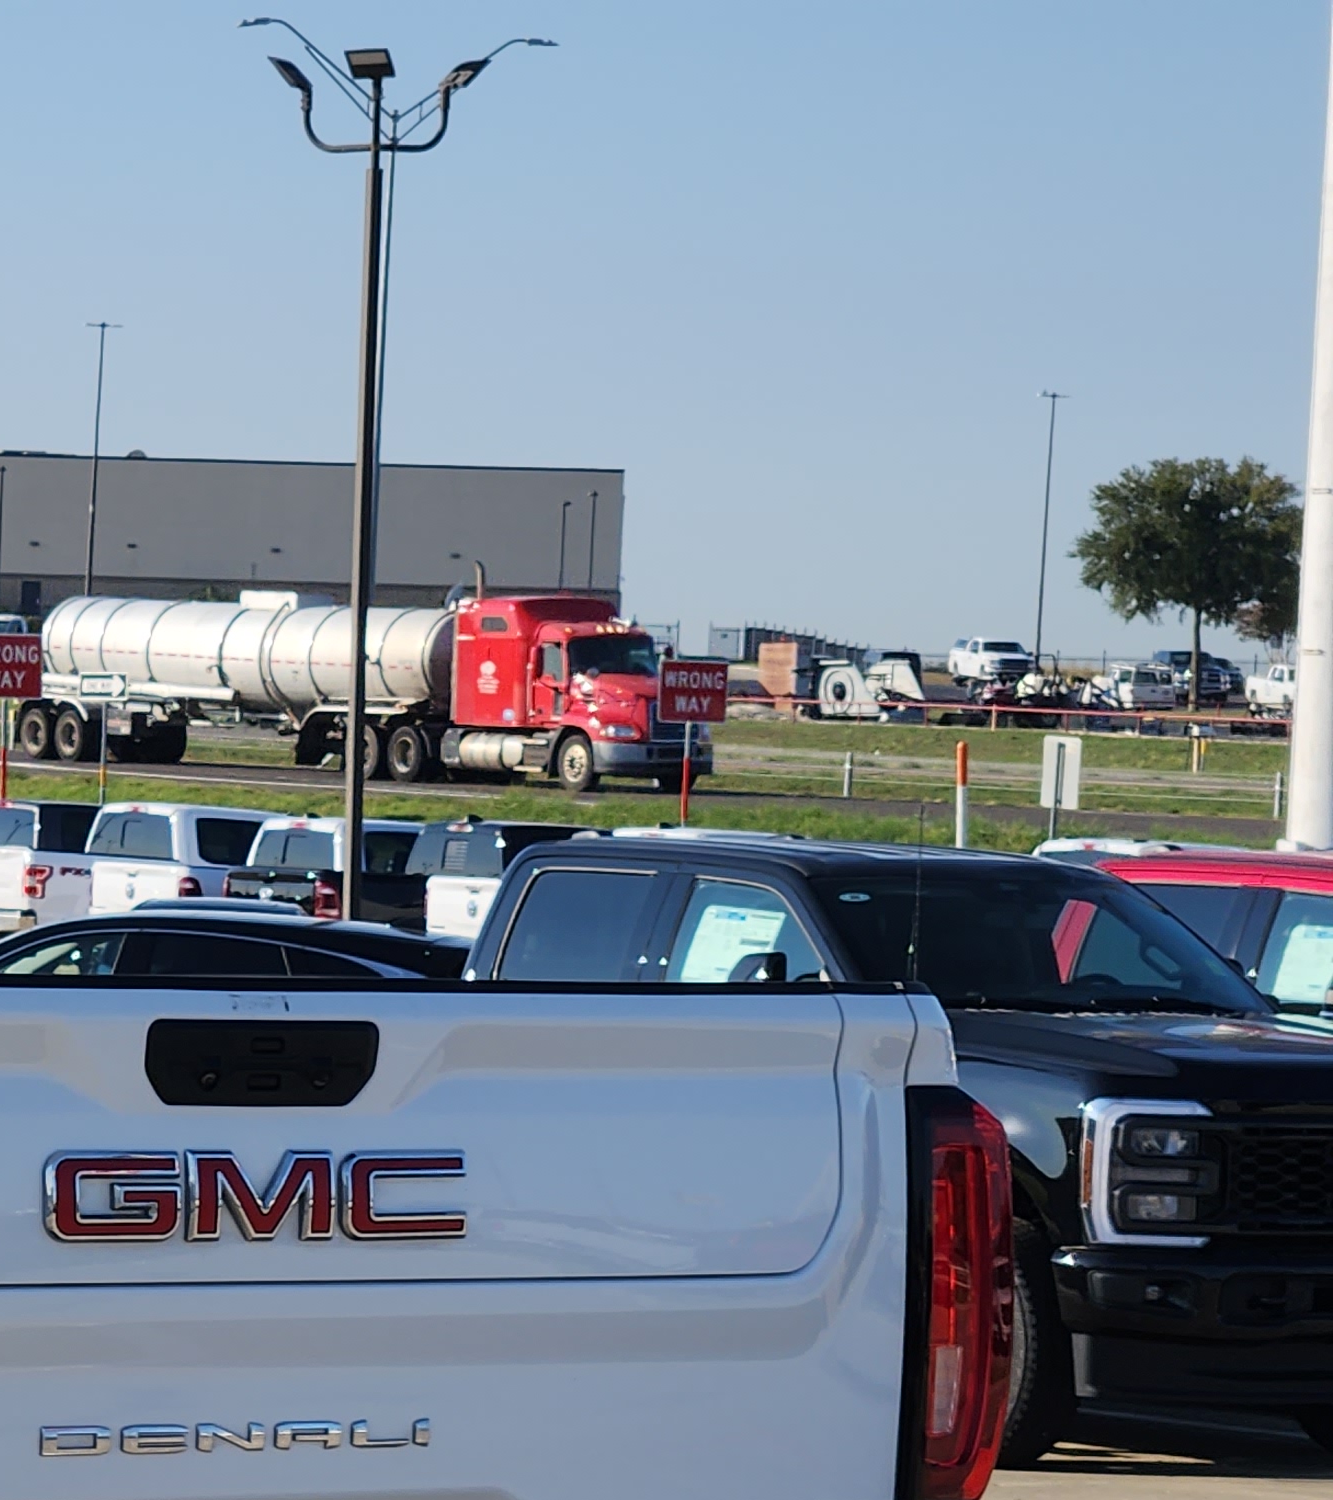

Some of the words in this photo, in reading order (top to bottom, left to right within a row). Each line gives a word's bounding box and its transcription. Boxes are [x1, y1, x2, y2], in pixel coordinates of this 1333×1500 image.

[664, 670, 725, 690] WRONG
[675, 695, 711, 713] WAY
[43, 1149, 467, 1242] GMC
[39, 1417, 430, 1457] DENALI
